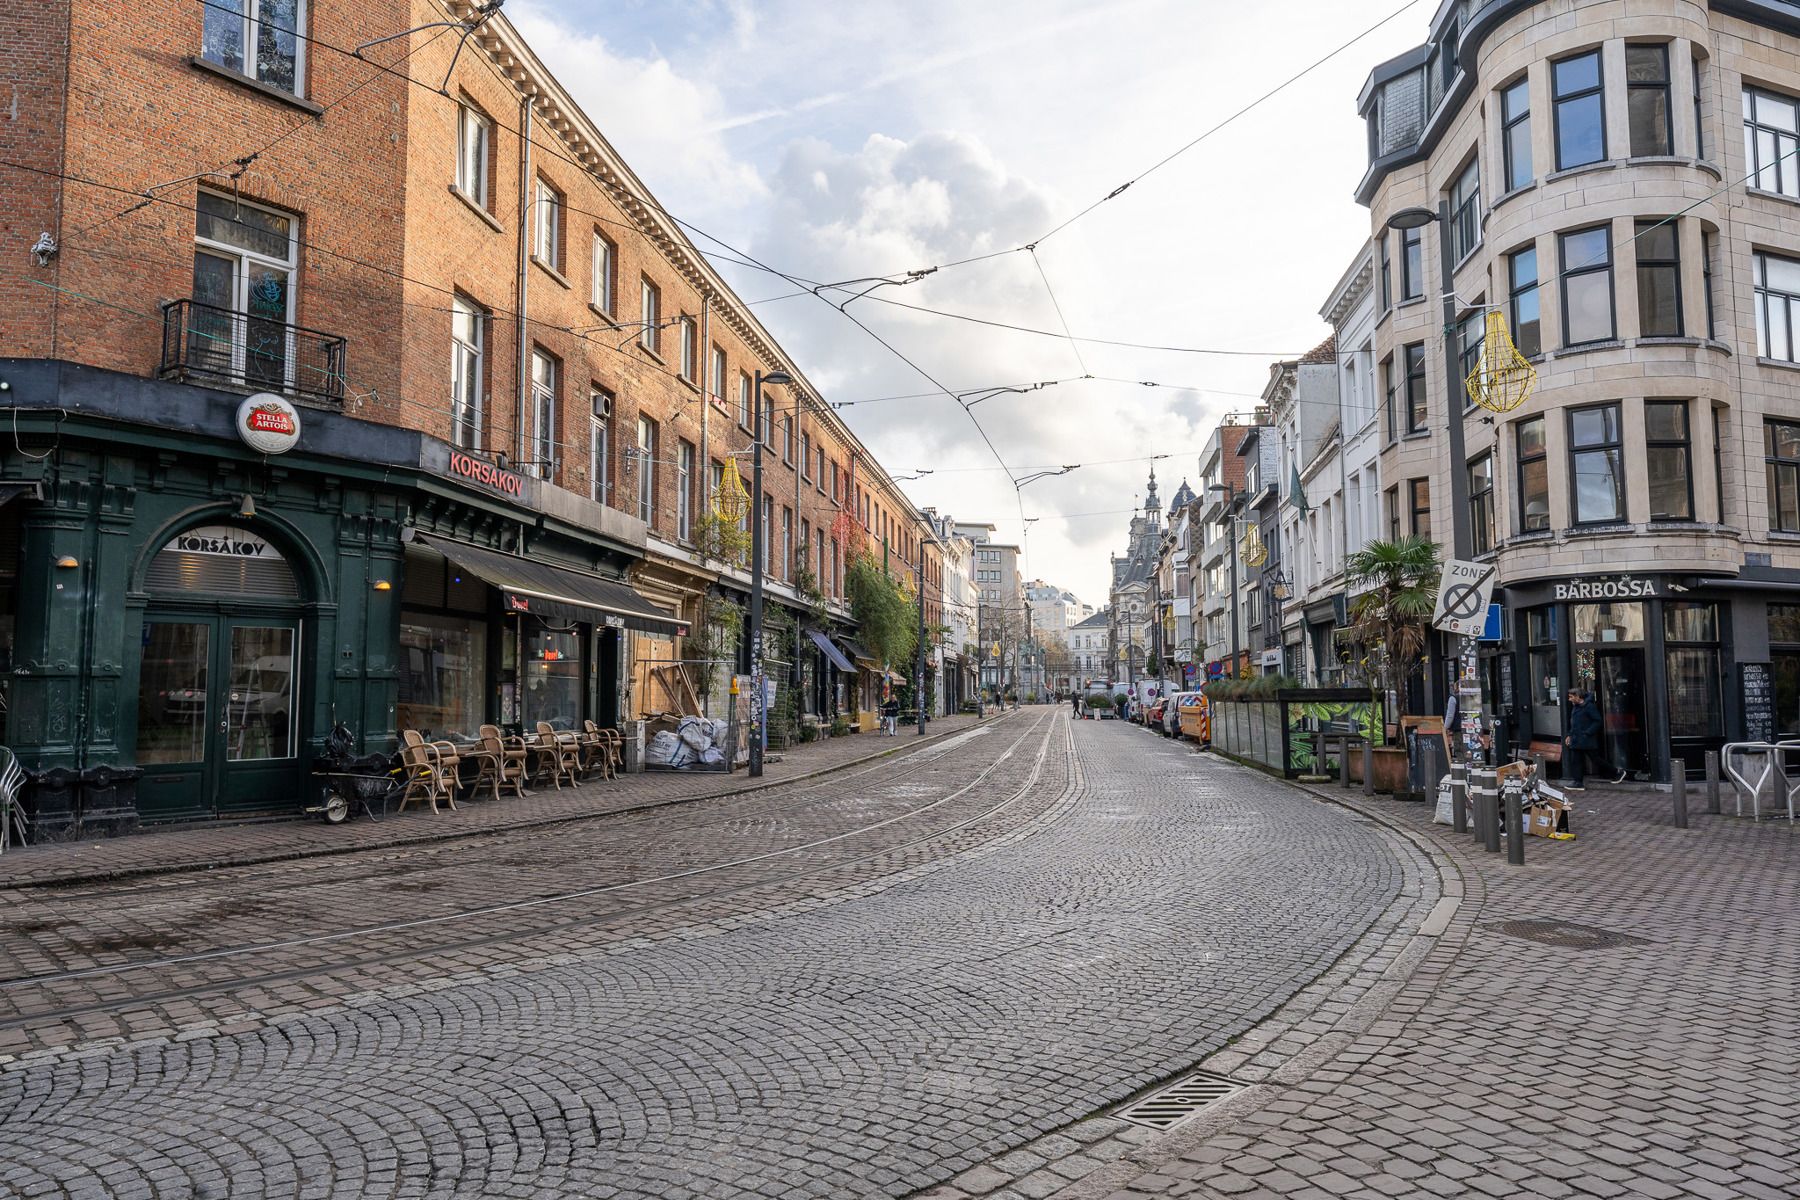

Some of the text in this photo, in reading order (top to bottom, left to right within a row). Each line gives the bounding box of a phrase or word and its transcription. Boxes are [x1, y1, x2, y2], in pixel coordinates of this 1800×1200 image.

[256, 413, 288, 423] STELLA
[256, 420, 288, 430] ARTOIS
[451, 451, 523, 496] KORSAKOV
[1555, 579, 1656, 599] BARBOSSA
